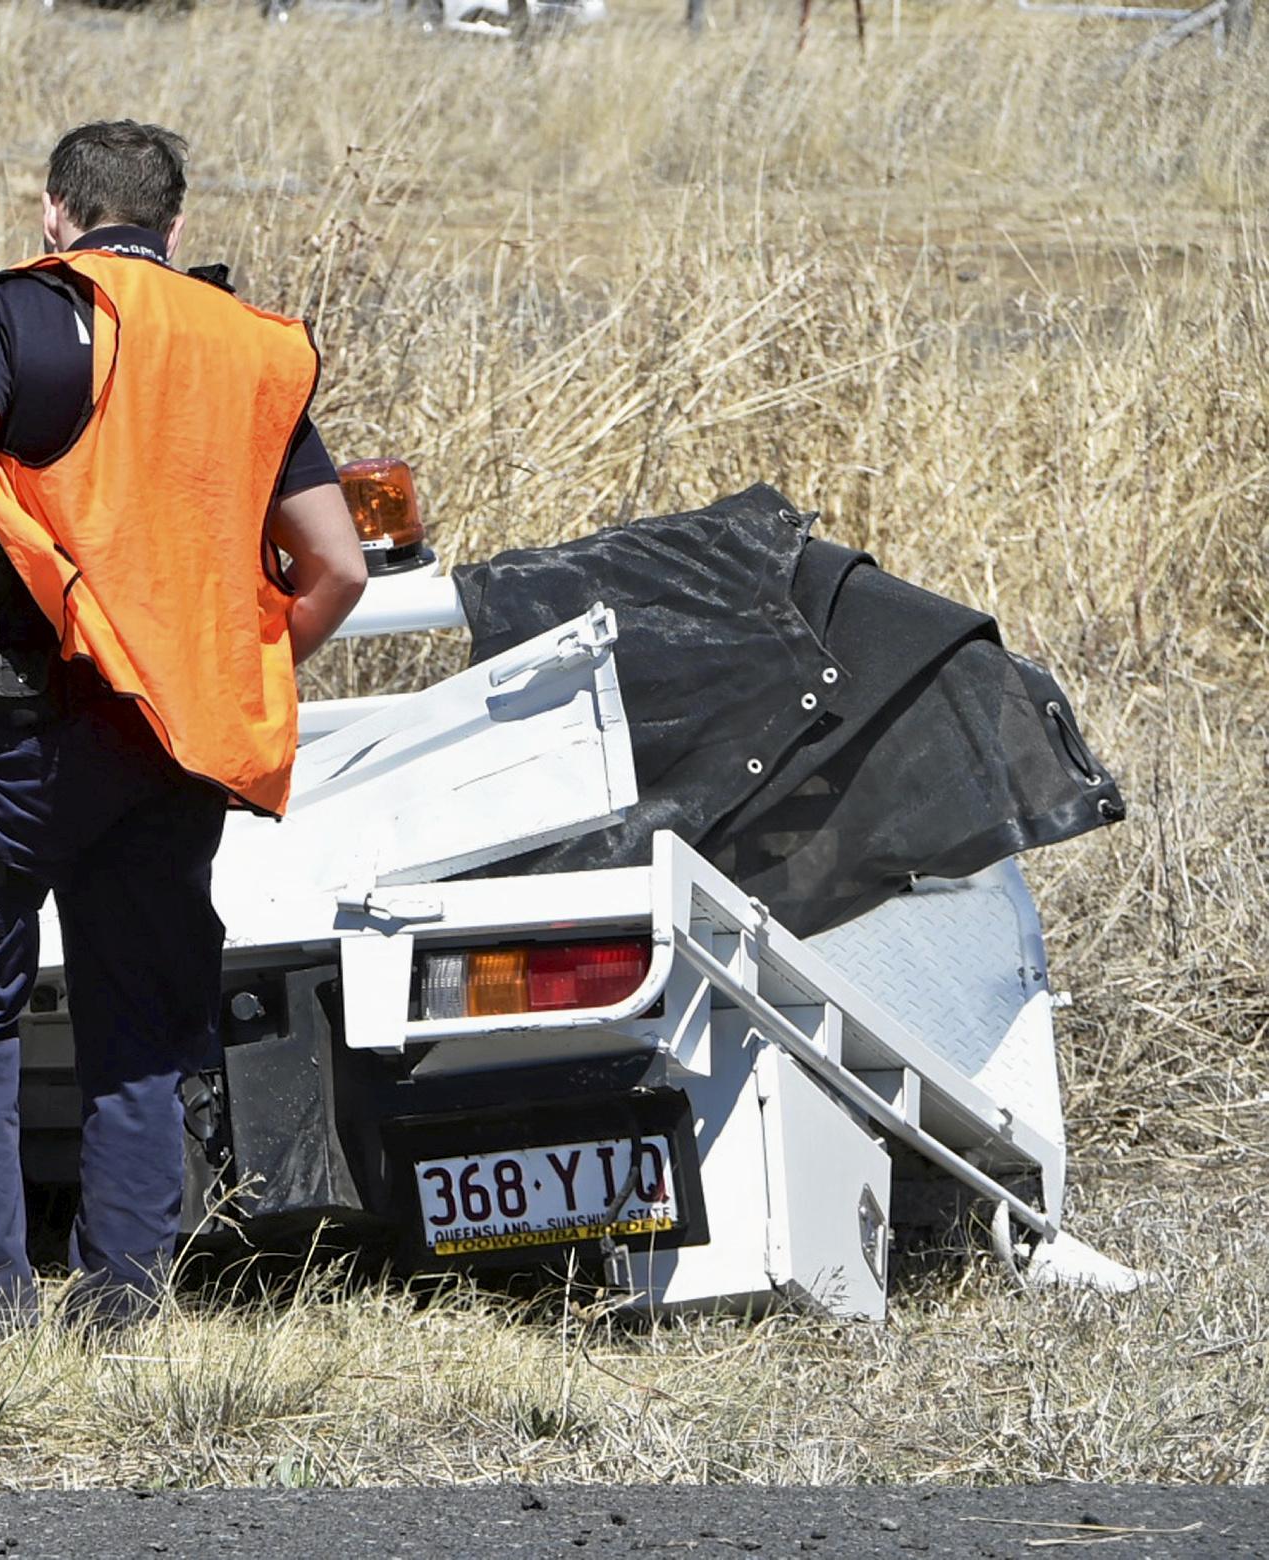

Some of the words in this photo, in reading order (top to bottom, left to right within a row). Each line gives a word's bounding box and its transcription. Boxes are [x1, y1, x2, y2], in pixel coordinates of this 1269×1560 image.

[434, 1220, 532, 1243] QUEENSLAND
[546, 1212, 608, 1231] SUNSHI
[451, 1227, 581, 1252] TOOWOOMBA
[586, 1218, 669, 1237] HOLDEN
